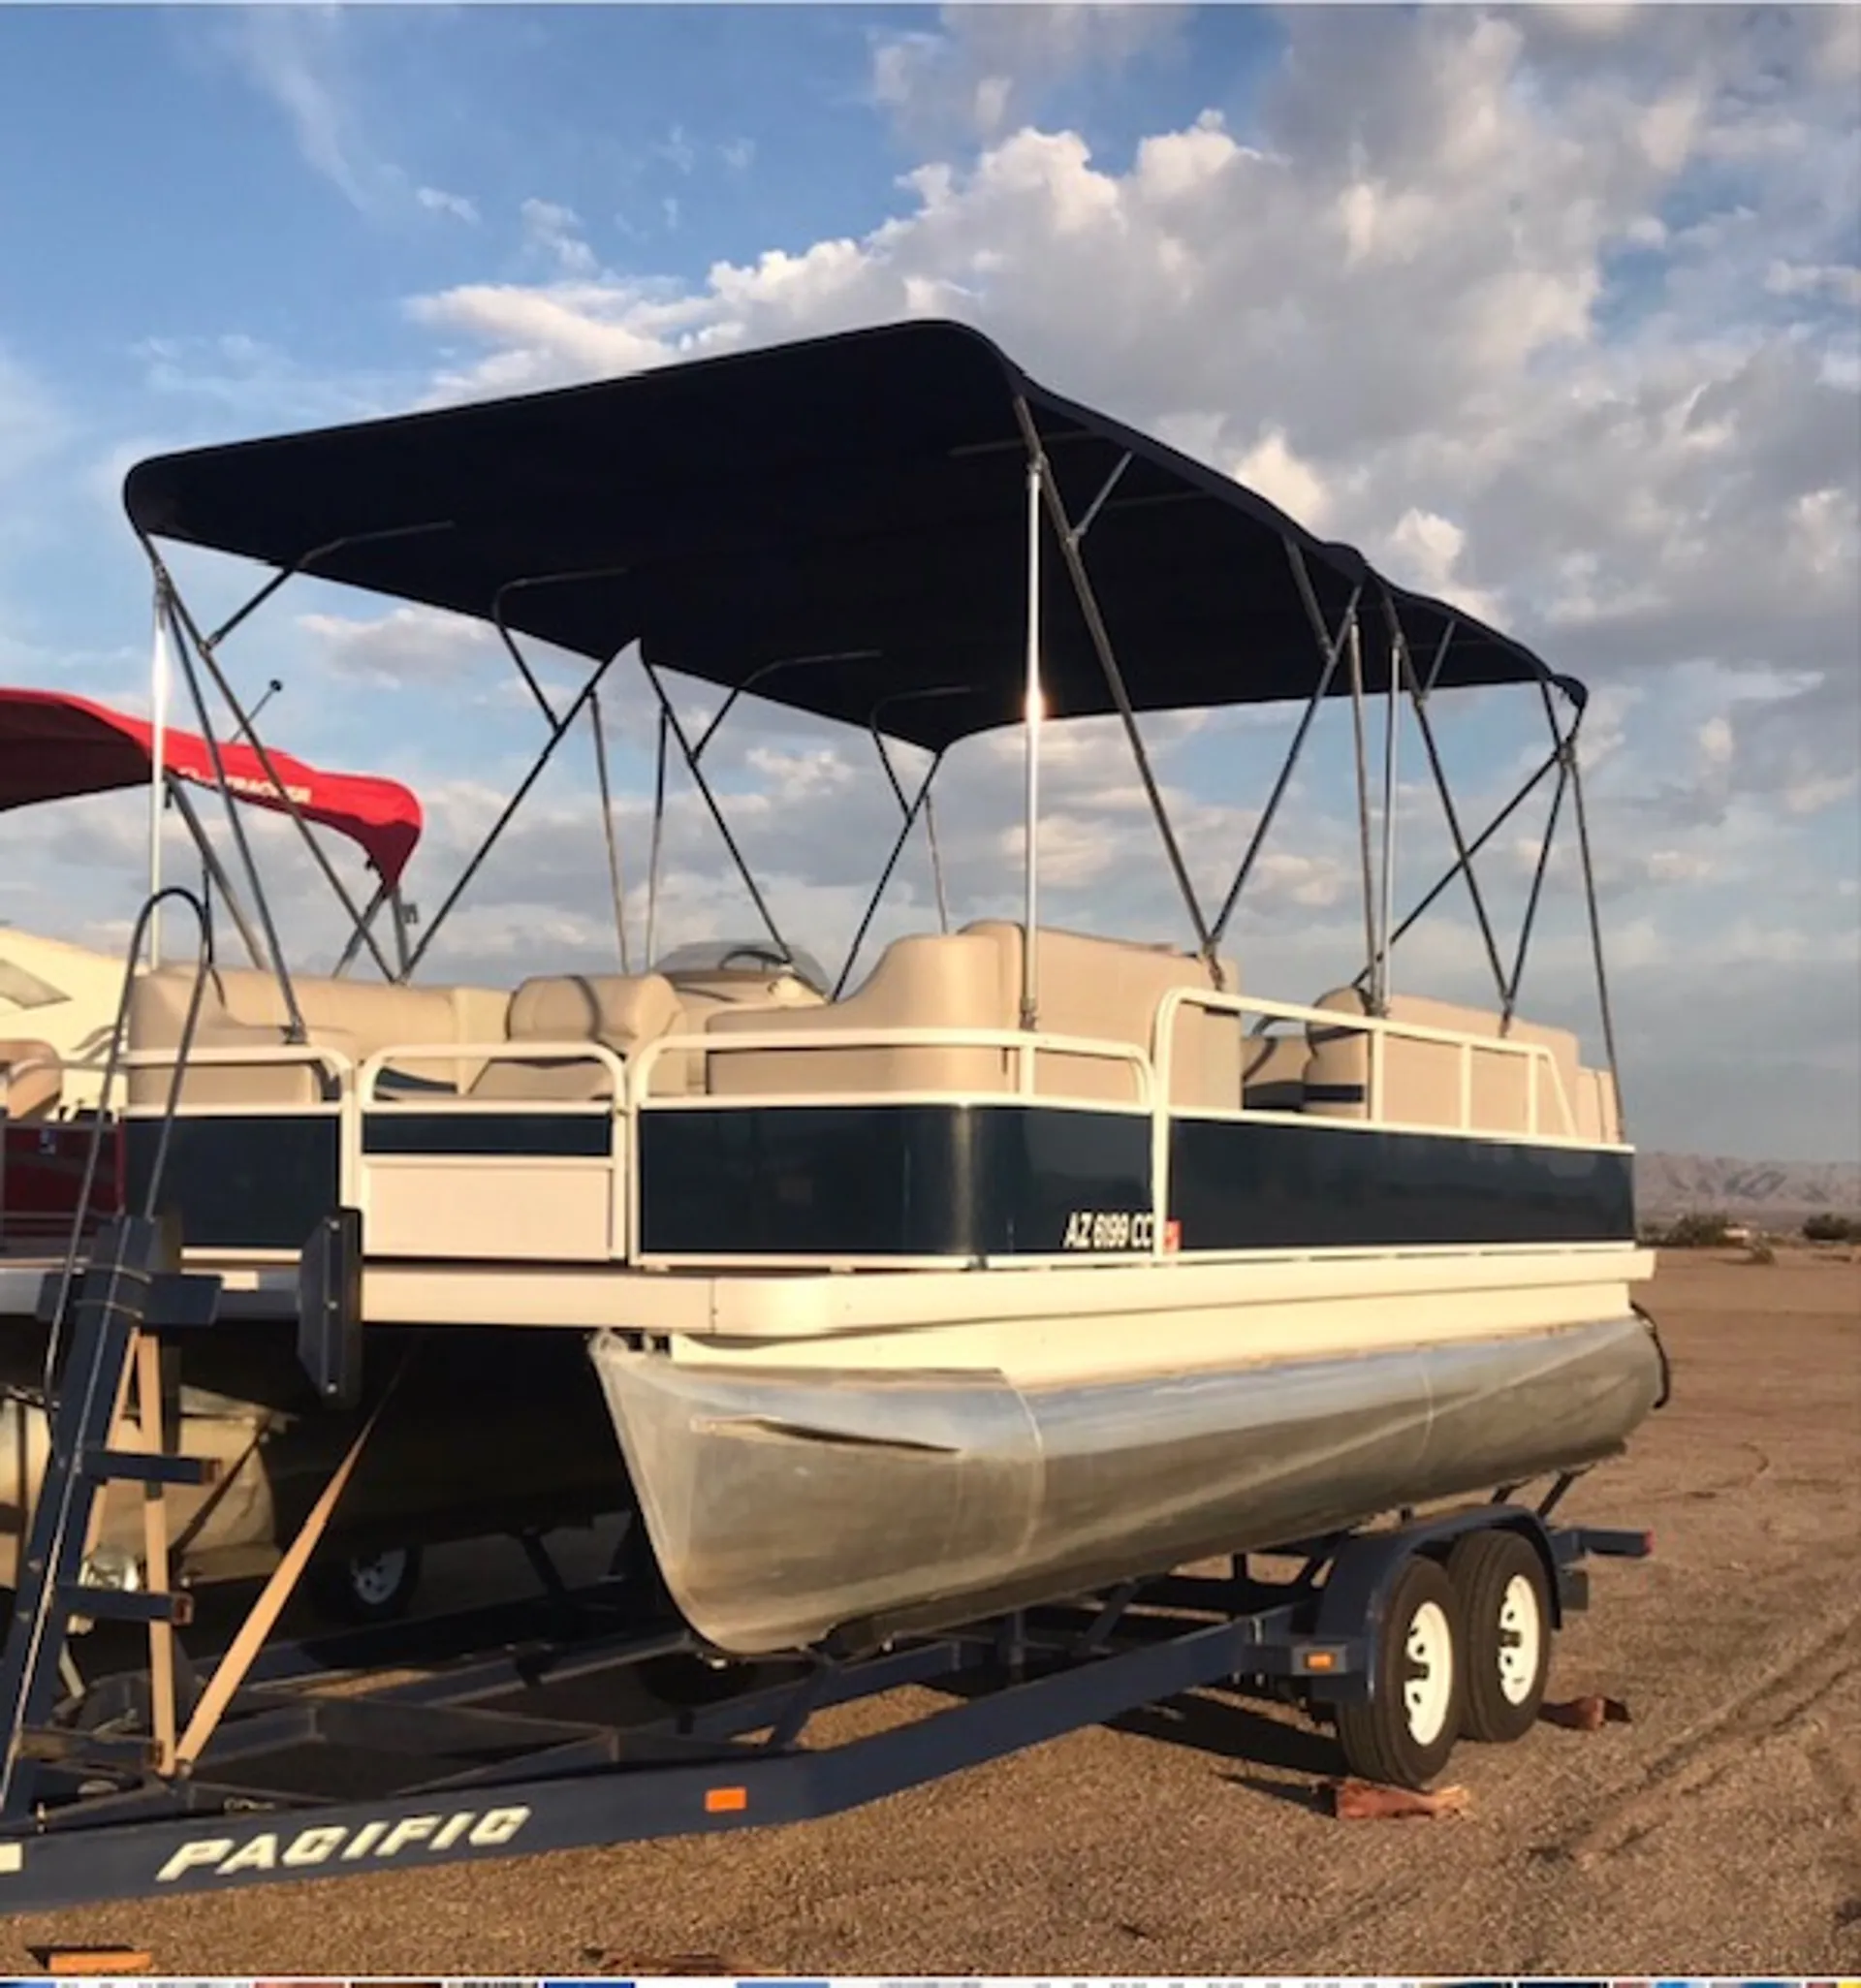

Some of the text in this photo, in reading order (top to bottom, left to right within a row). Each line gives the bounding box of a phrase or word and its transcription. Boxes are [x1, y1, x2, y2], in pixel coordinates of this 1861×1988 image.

[223, 774, 312, 805] TRACER
[1063, 1212, 1093, 1248] AZ
[155, 1806, 532, 1882] PACIFIC
